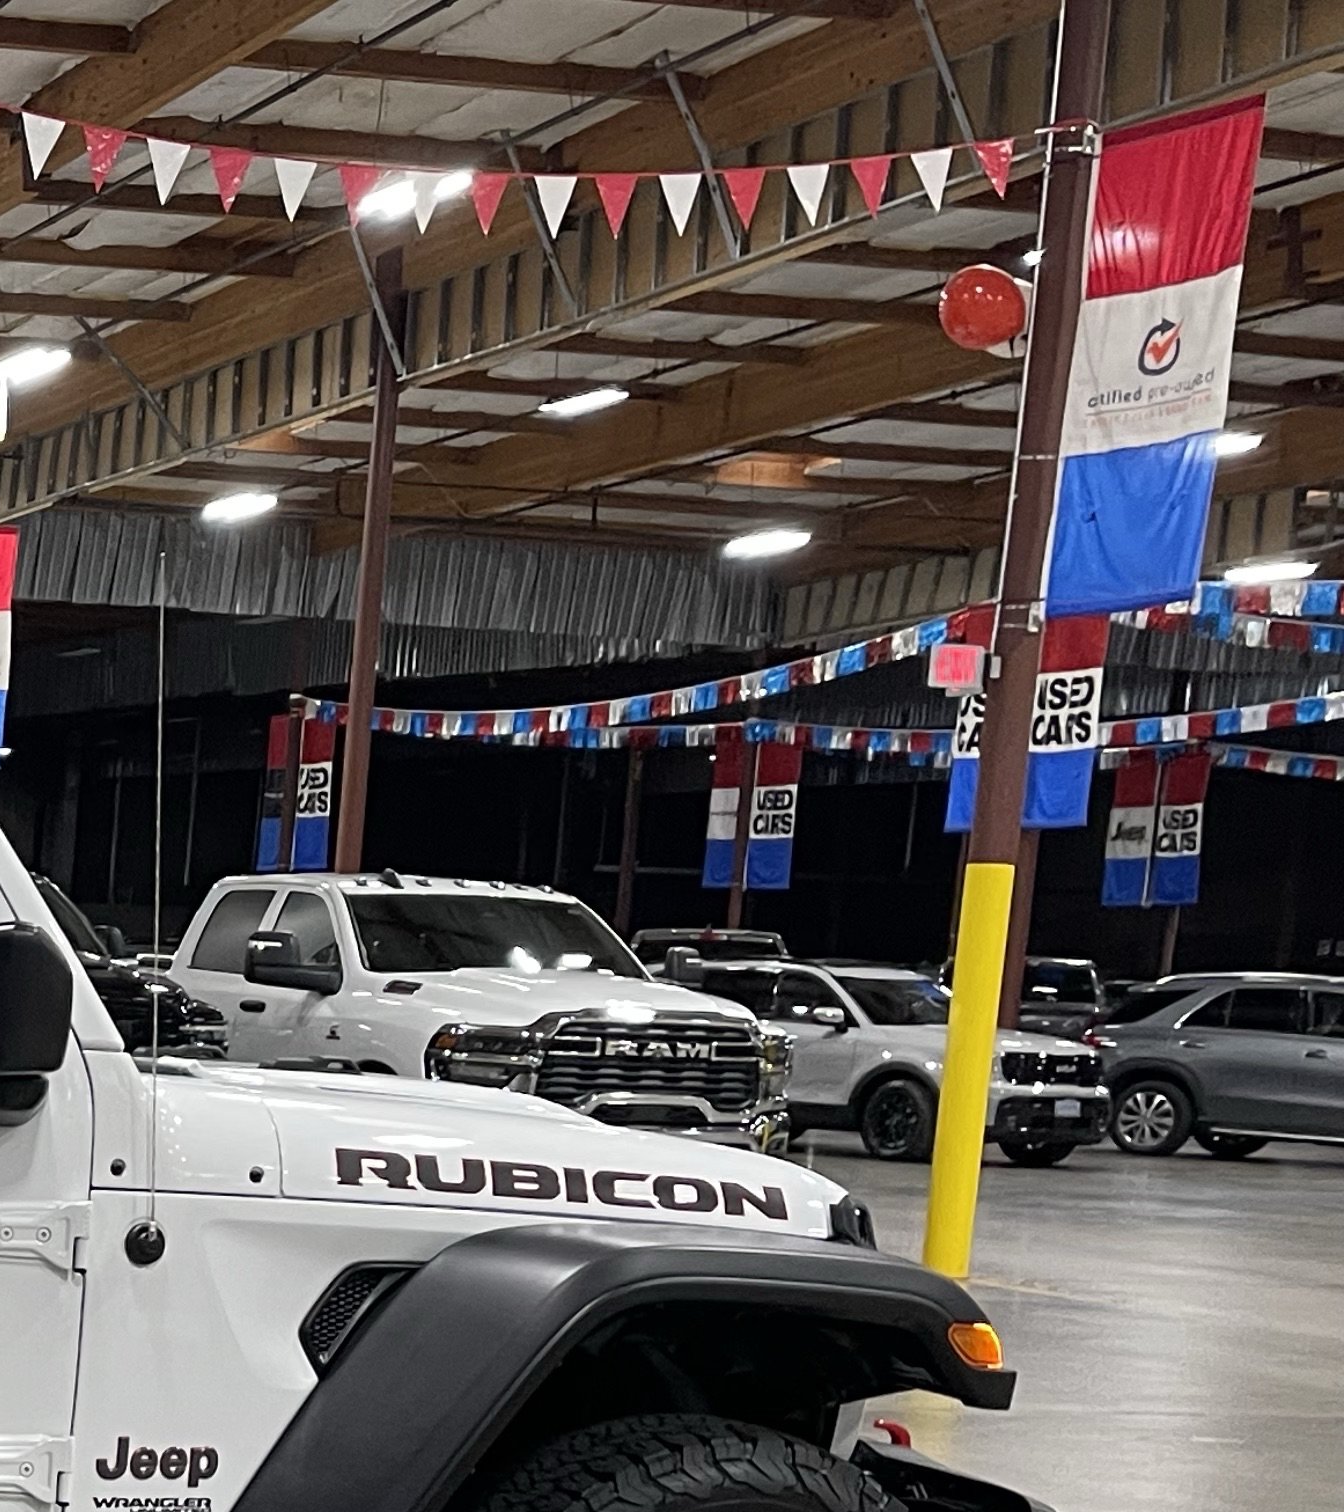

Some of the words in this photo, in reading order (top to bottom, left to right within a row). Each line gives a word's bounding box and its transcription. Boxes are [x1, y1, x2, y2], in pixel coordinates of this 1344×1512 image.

[605, 1040, 710, 1058] RAM
[335, 1147, 789, 1220] RUBICON
[95, 1436, 219, 1488] Jeep
[92, 1496, 212, 1509] WRANGLER
